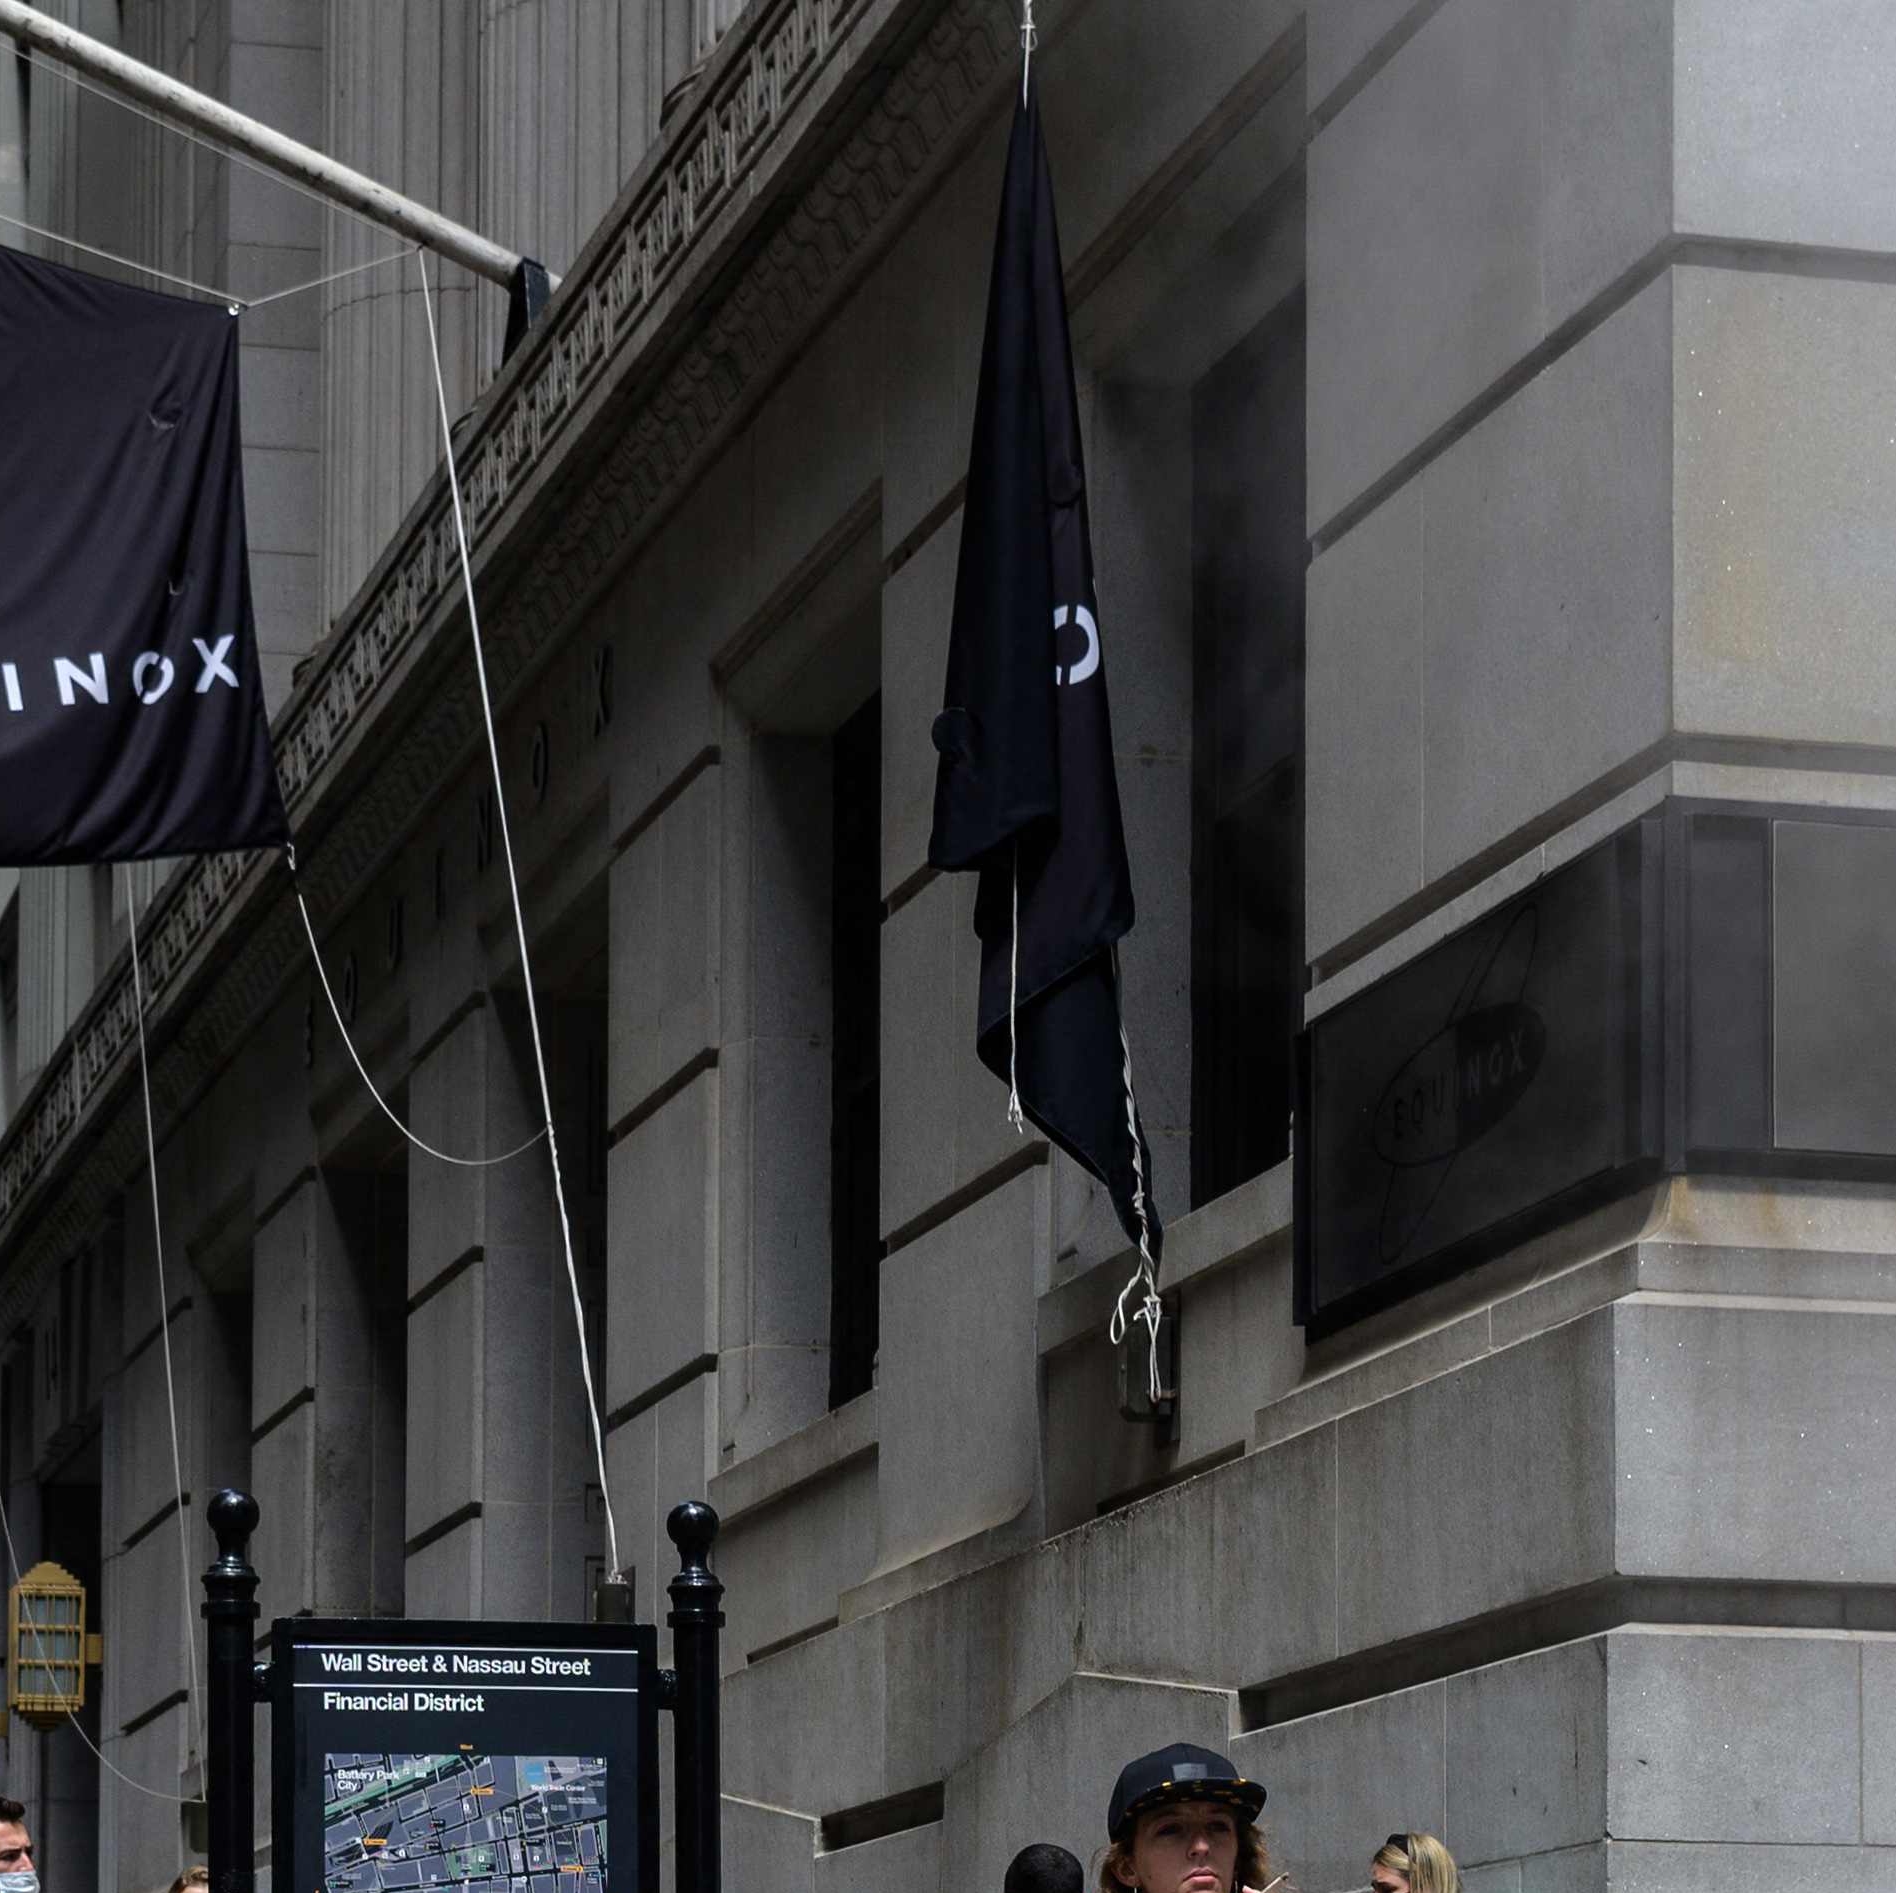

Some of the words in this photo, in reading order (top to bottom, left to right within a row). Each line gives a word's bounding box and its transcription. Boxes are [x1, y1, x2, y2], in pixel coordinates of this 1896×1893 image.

[1392, 1027, 1528, 1142] EQUINOX
[322, 1653, 362, 1673] Wall
[367, 1654, 428, 1674] Street
[432, 1656, 447, 1674] &
[453, 1656, 526, 1675] Nassau
[530, 1658, 591, 1676] Street
[324, 1693, 408, 1711] Financial
[414, 1694, 484, 1712] District
[337, 1781, 358, 1791] City
